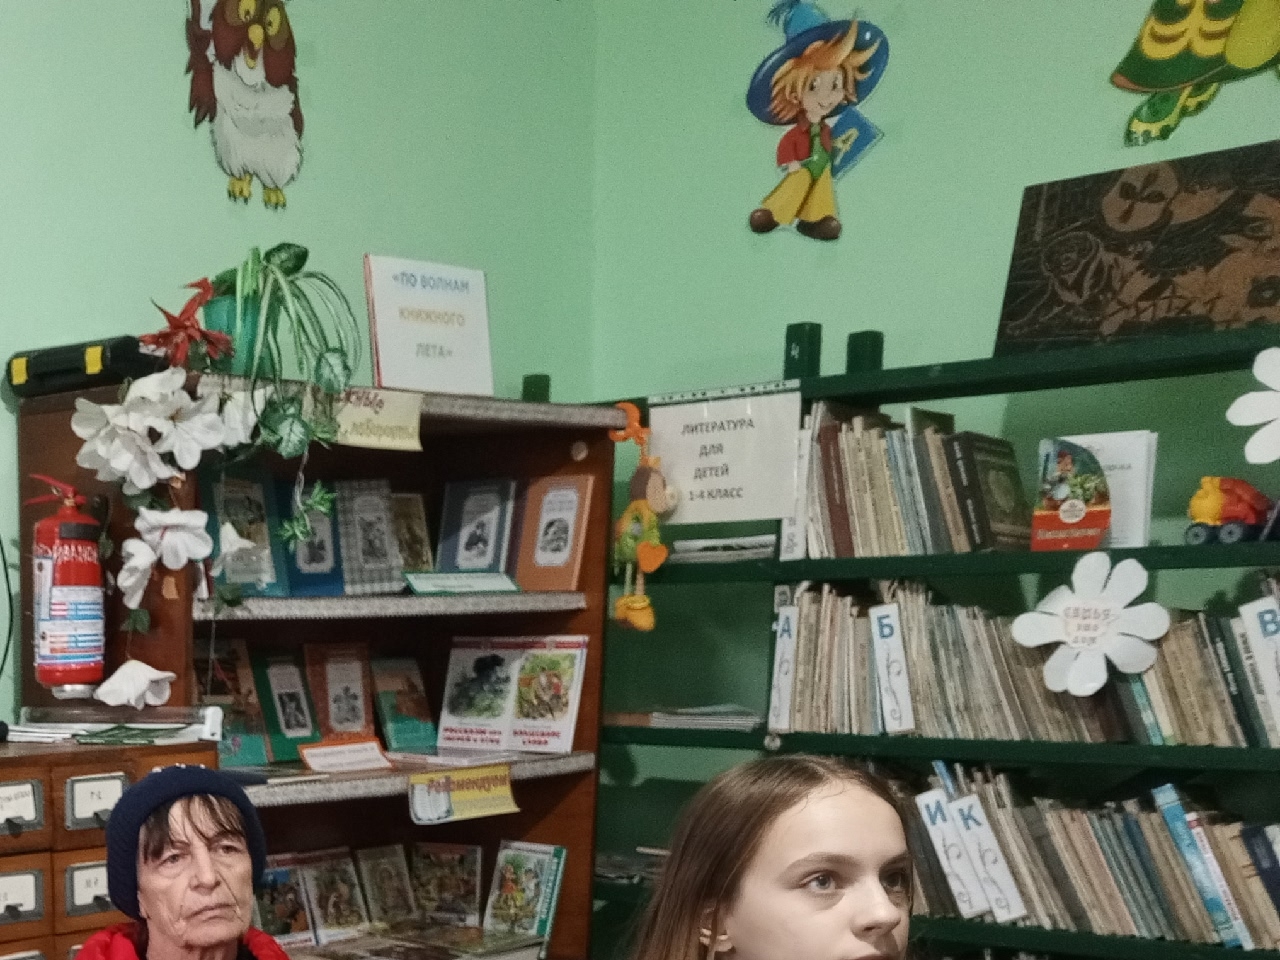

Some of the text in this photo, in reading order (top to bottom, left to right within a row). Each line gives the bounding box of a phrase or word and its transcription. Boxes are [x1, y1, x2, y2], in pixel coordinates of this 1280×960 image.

[421, 275, 469, 294] ВОЛНАМ
[399, 307, 465, 326] КНИЖНОГО
[681, 418, 755, 435] ЛИТЕРАТУРА
[699, 443, 724, 458] ДЛЯ
[693, 463, 730, 480] ДЕТЕЙ
[707, 487, 744, 500] КЛАСС
[779, 616, 793, 640] А
[877, 615, 894, 639] Б
[1257, 608, 1280, 639] В
[924, 800, 948, 827] И
[958, 804, 982, 830] К
